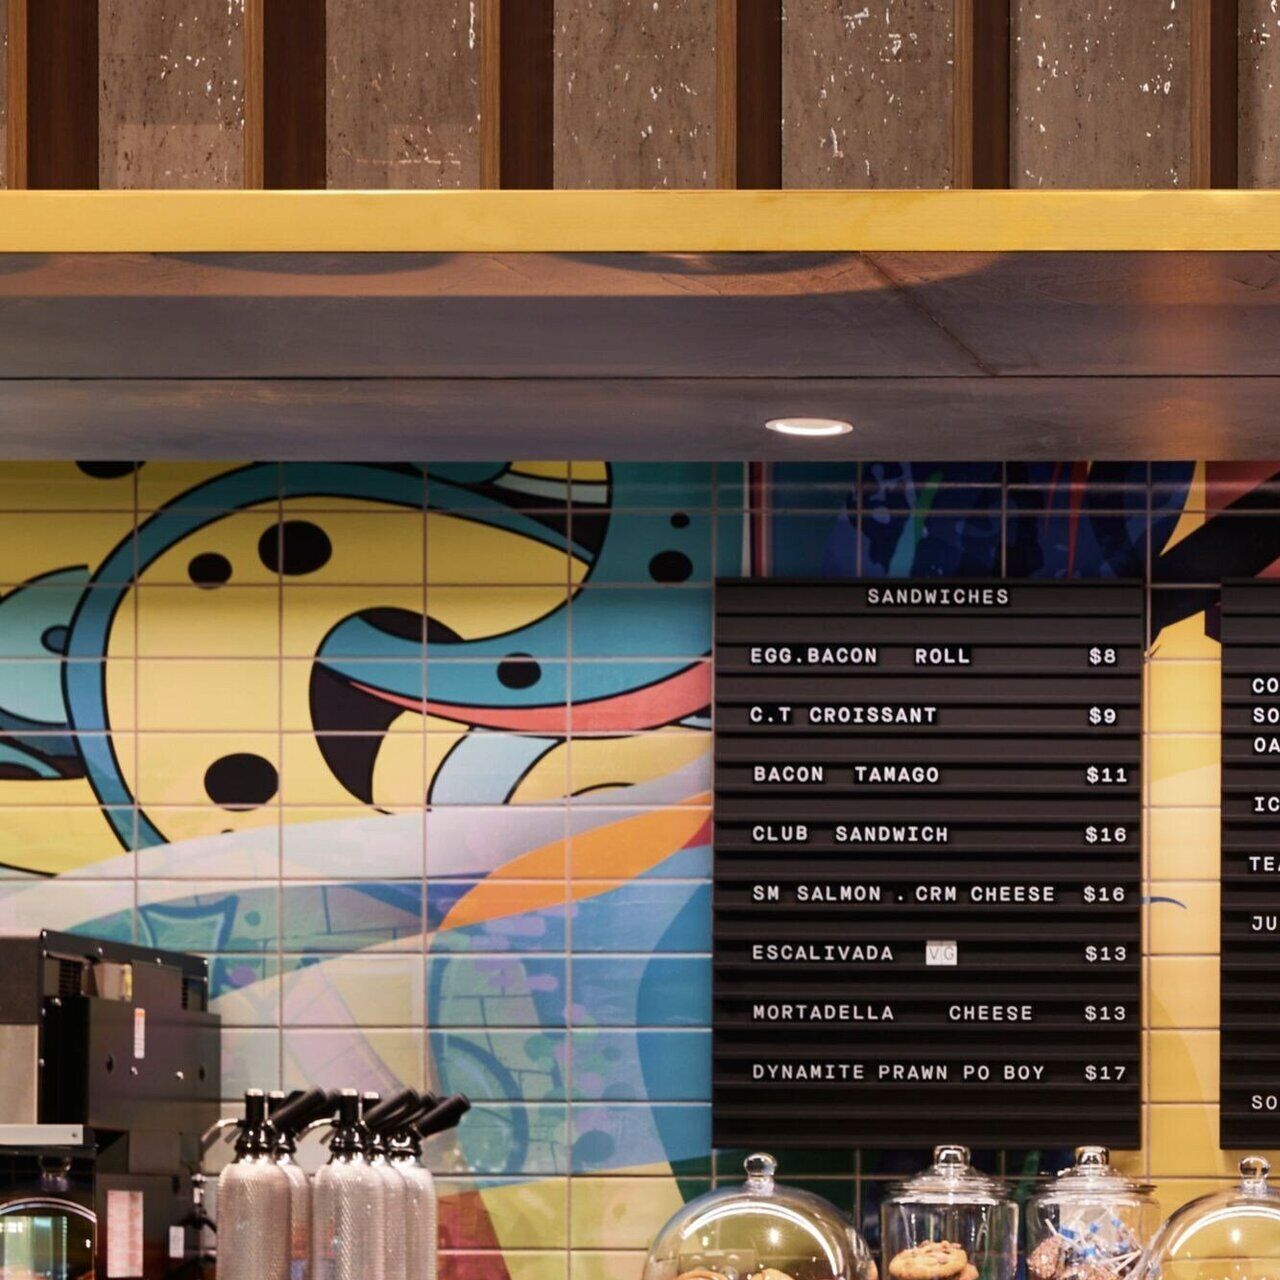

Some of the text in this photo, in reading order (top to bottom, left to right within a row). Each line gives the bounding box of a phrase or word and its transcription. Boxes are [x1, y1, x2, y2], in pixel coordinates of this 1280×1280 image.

[868, 589, 1008, 604] SANDWICHES
[751, 648, 1115, 664] EGG.BACON ROLL $8
[750, 707, 1115, 724] C.T CROISSANT $9
[755, 766, 1126, 783] BACON TAMAGO $11
[753, 826, 1126, 843] CLUB SANDWICH $16
[754, 886, 778, 900] SM
[798, 886, 880, 900] SALMON
[916, 886, 956, 901] CRM
[971, 886, 1053, 901] CHEESE
[1084, 886, 1124, 902] $16
[753, 945, 1126, 961] ESCALIVADA VG $13
[754, 1005, 1125, 1021] MORTADELLA CHEESE $13
[753, 1065, 1125, 1081] DYNAMITE PRAWN PO BOY $17
